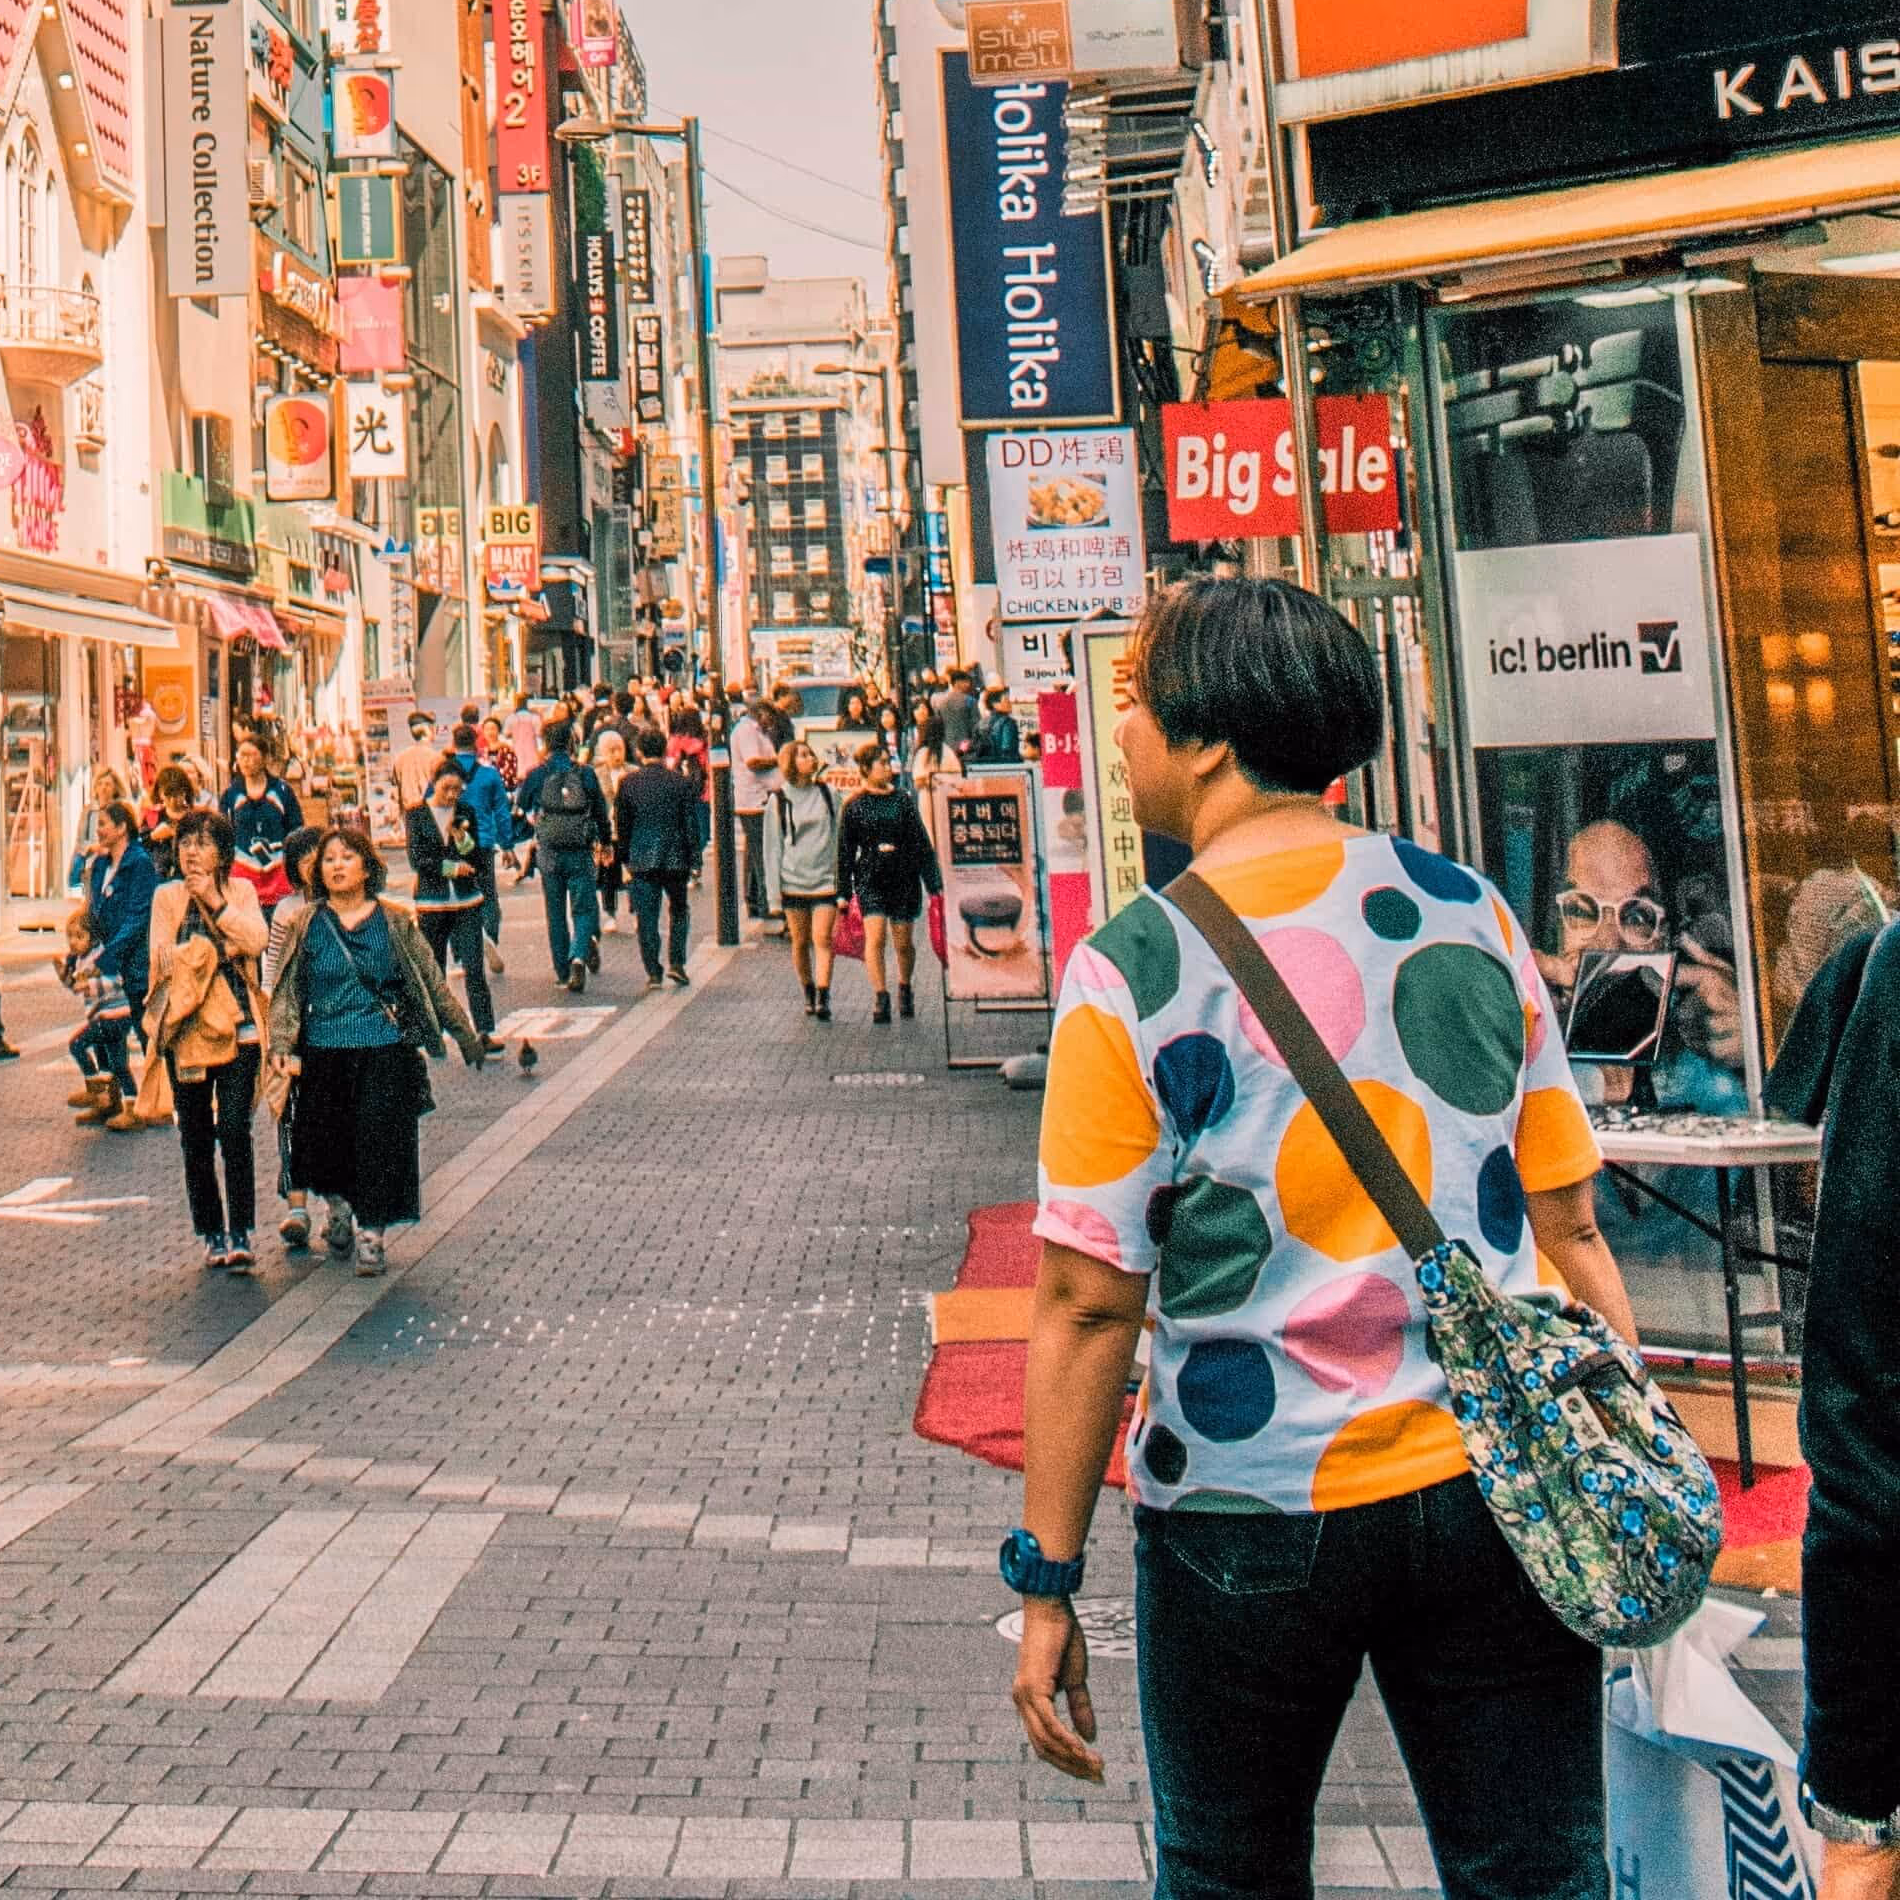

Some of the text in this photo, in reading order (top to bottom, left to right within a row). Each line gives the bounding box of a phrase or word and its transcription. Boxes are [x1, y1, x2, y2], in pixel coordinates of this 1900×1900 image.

[979, 50, 1061, 72] mall
[504, 93, 527, 128] 2
[189, 15, 218, 286] Nature Collection
[517, 164, 541, 187] 3F
[993, 82, 1061, 409] Holika Holika
[587, 236, 608, 377] HOLLYS COFFEE
[353, 406, 394, 454] 光
[1001, 439, 1053, 468] DD
[1176, 425, 1389, 513] Big Sale
[492, 511, 531, 535] BIG
[491, 546, 533, 572] MART
[1006, 599, 1080, 615] CHICKEN
[1091, 598, 1124, 612] PUB
[1489, 628, 1632, 674] ic! berlin
